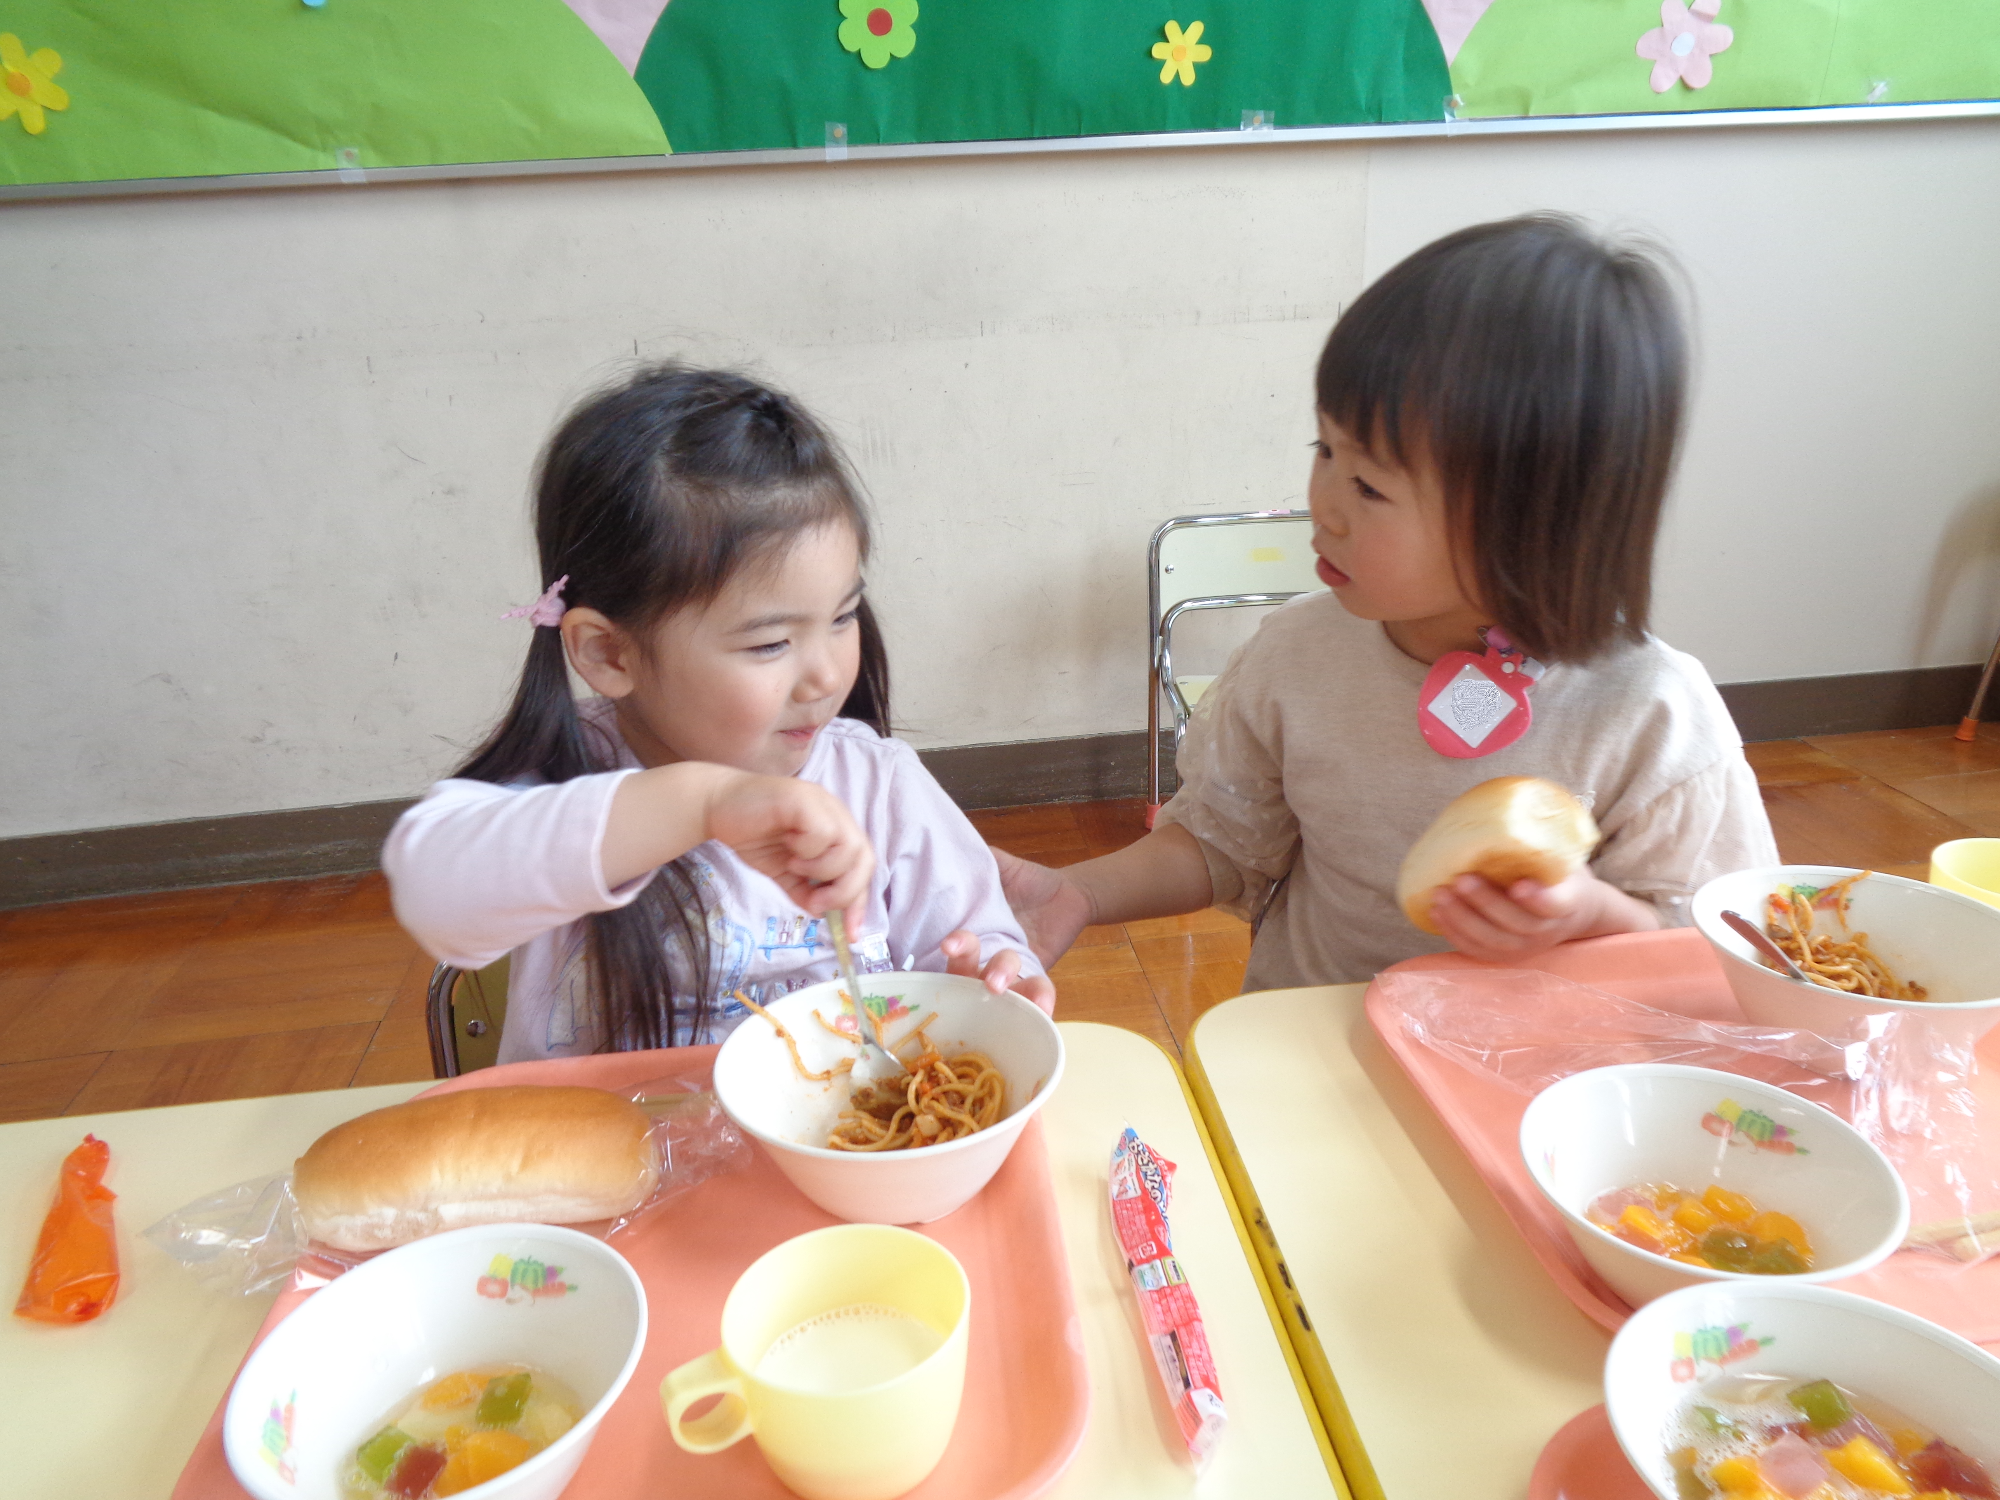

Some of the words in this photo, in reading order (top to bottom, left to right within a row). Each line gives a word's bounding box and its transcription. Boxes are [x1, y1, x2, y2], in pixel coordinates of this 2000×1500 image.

[1128, 1136, 1166, 1211] おさかなの
